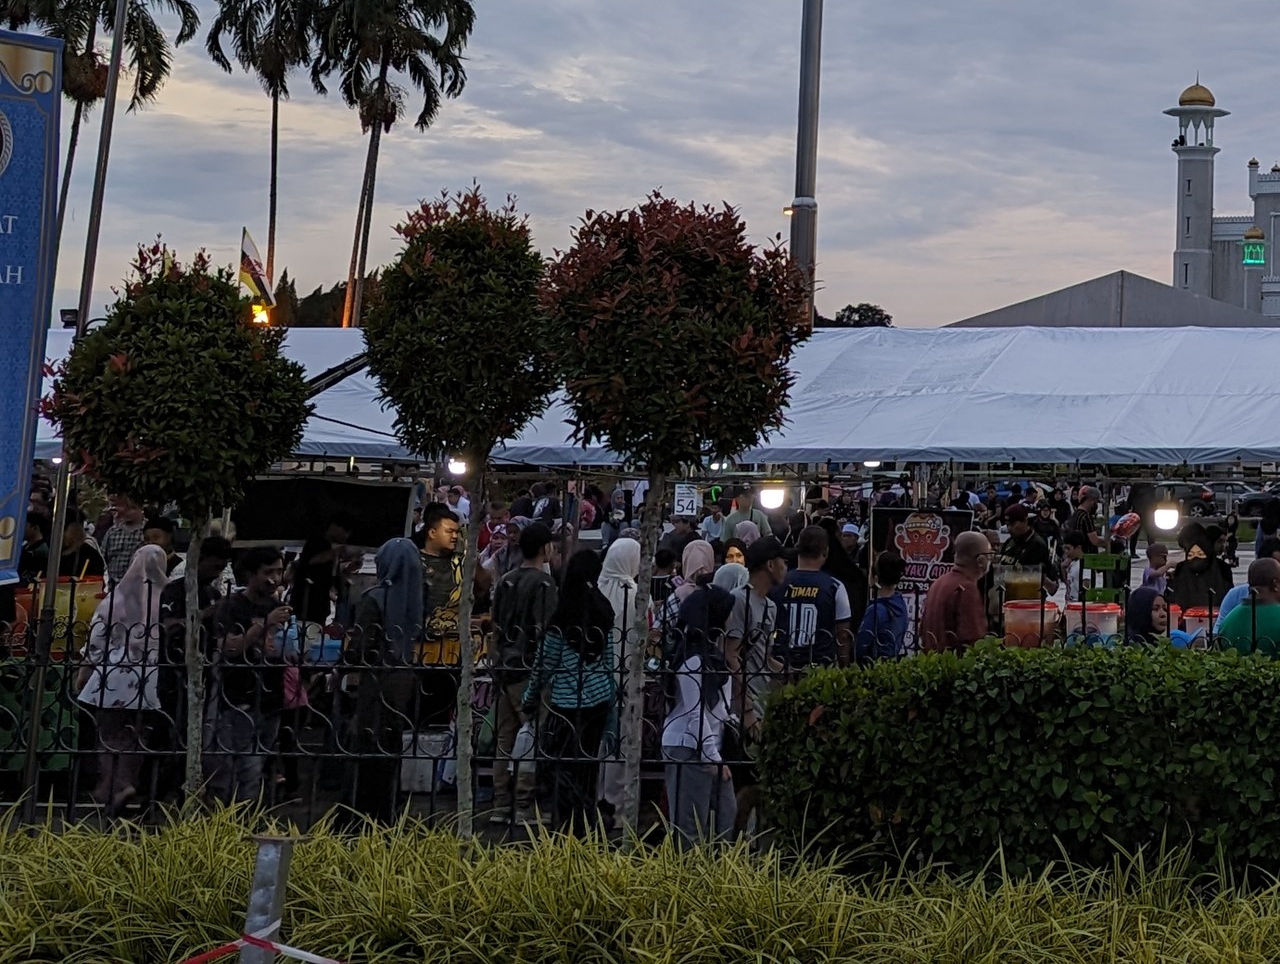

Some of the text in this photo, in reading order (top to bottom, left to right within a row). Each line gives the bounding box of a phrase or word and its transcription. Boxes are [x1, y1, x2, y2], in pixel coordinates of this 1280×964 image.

[0, 214, 18, 234] T
[0, 265, 24, 284] H
[676, 499, 695, 513] 54
[904, 564, 927, 577] YAKI
[783, 603, 818, 647] 10
